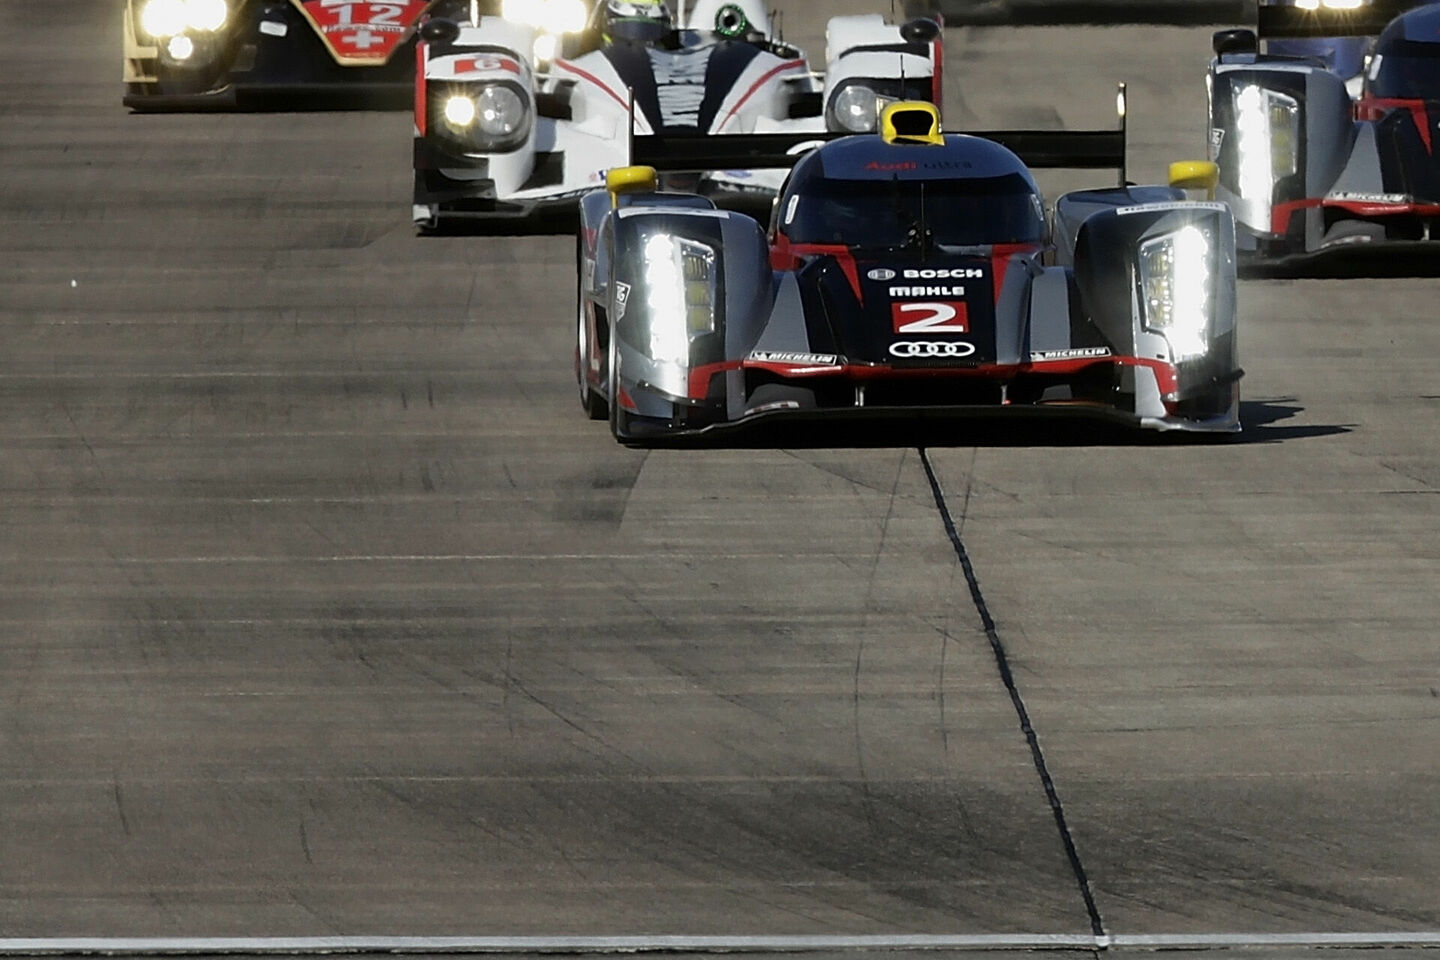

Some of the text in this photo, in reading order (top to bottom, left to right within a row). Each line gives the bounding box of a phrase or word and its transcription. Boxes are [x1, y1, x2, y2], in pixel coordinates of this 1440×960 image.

[328, 3, 404, 27] 12
[865, 160, 917, 171] Audi
[903, 269, 984, 279] BOSCH
[889, 286, 965, 297] MAHLE
[898, 302, 965, 333] 2
[768, 352, 835, 364] MICHELIN
[1044, 348, 1107, 359] MICHELIN
